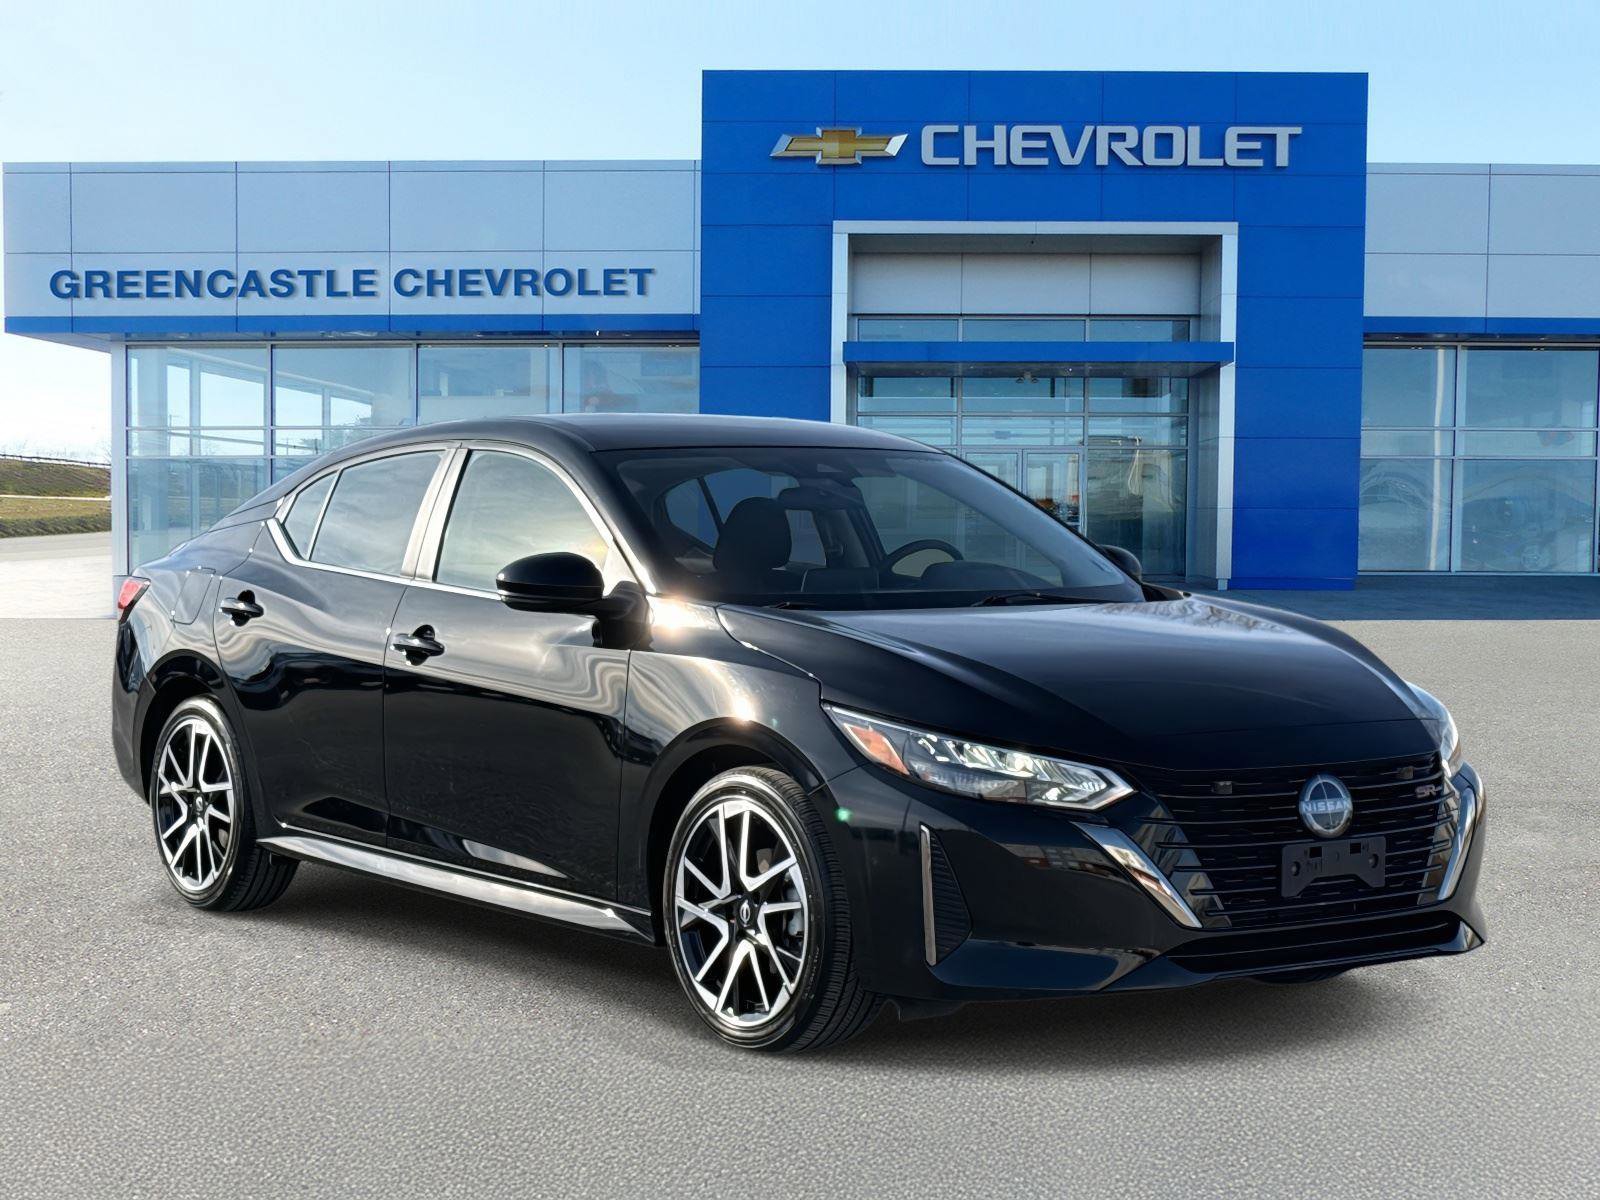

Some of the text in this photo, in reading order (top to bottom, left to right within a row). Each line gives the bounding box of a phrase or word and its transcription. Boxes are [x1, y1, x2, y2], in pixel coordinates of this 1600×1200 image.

[921, 125, 1302, 167] CHEVROLET
[50, 268, 655, 299] GREENCASTLE CHEVROLET
